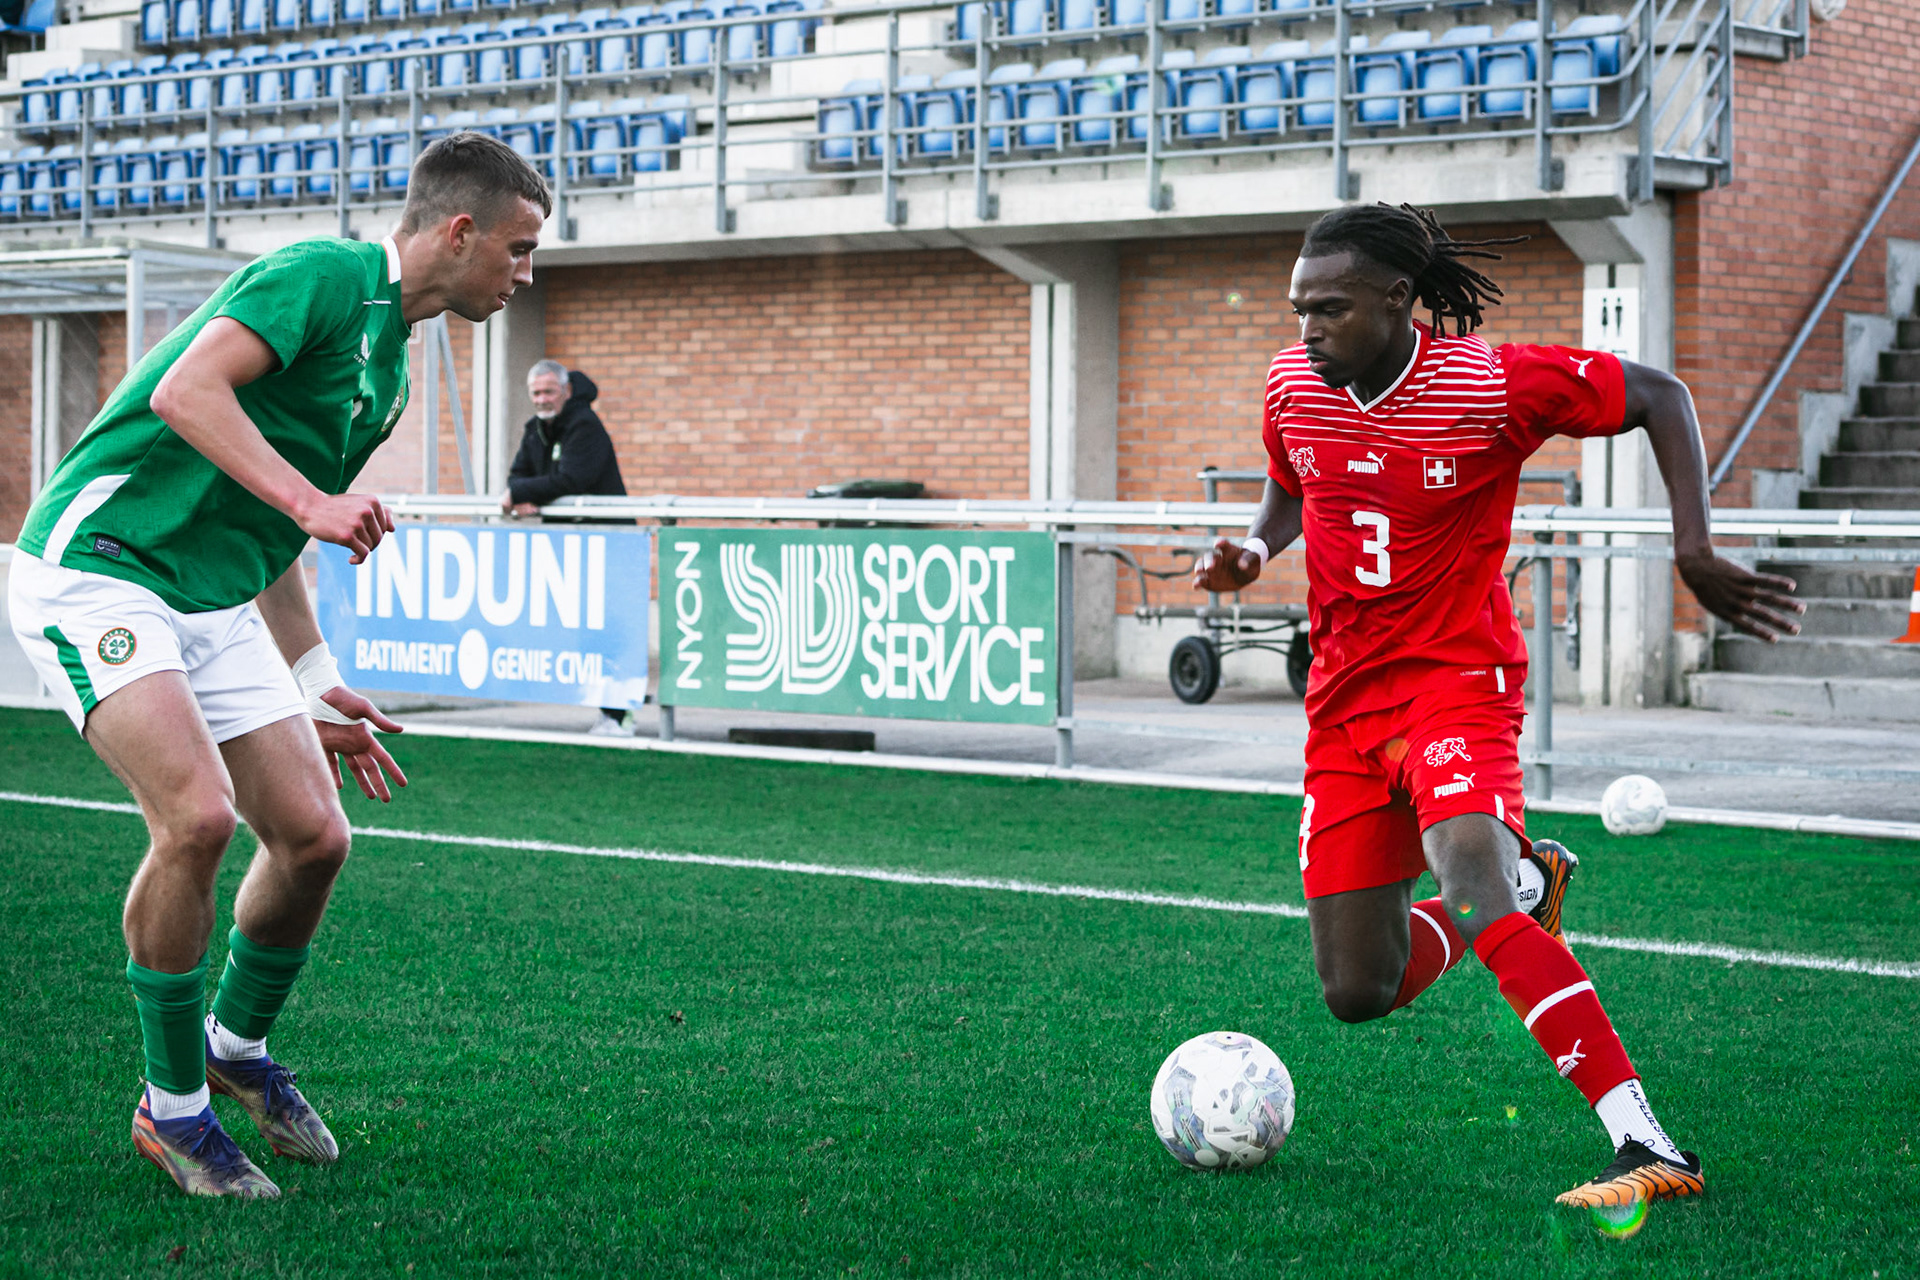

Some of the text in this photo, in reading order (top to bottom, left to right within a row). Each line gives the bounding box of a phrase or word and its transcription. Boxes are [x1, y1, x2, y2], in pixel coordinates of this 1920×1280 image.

[1347, 459, 1379, 474] PUMA
[355, 528, 606, 630] INDUNI
[861, 542, 1016, 625] SPORT
[1351, 510, 1392, 588] 3
[674, 541, 703, 690] NYON
[355, 639, 456, 675] BATIMENT
[492, 647, 604, 686] GENIE CIVIL
[860, 621, 1046, 706] SERVICE
[1433, 781, 1469, 799] PUMA
